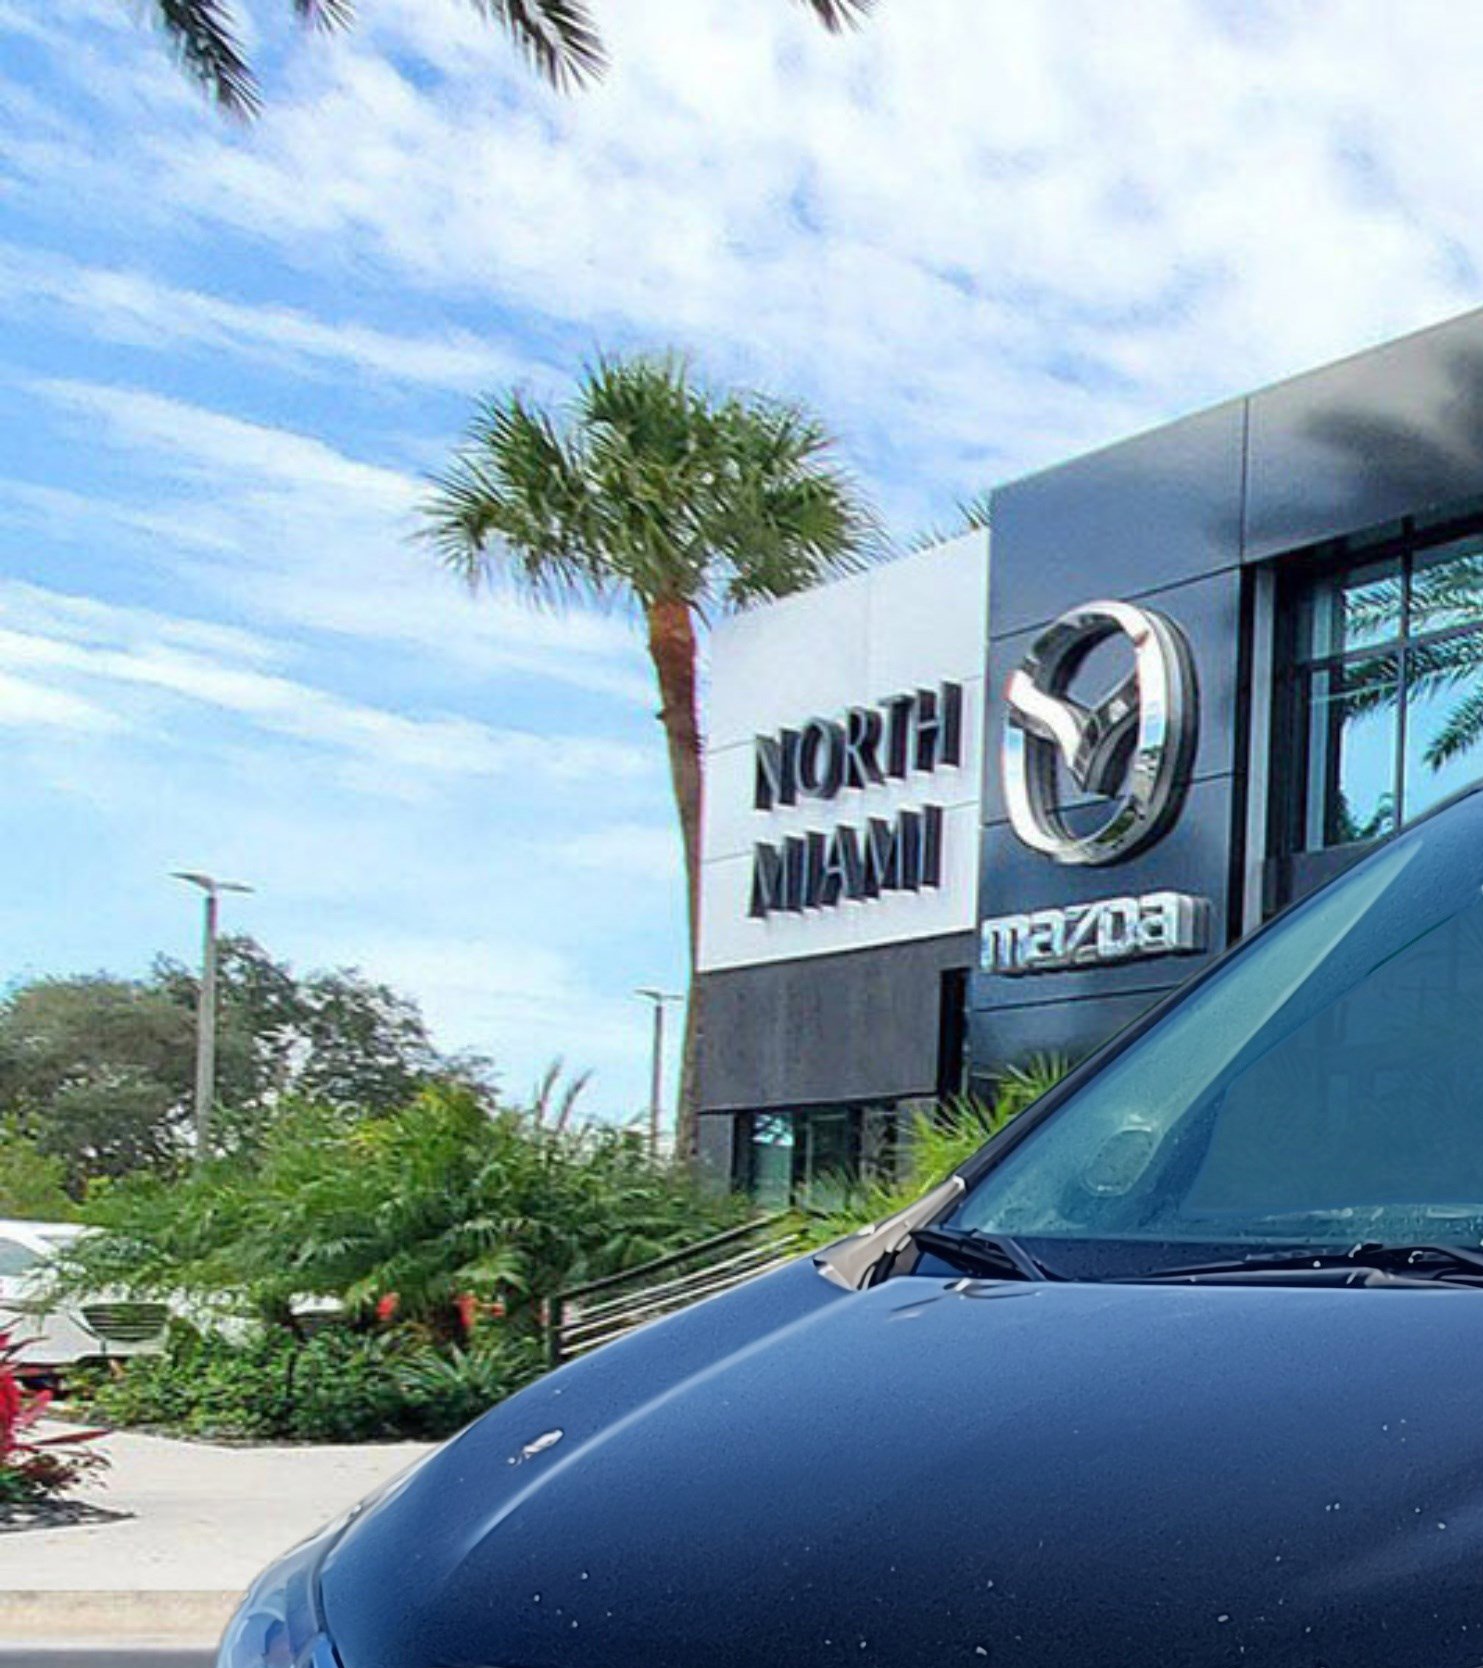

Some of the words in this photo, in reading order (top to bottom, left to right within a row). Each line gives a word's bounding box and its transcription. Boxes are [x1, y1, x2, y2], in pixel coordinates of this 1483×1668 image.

[754, 681, 963, 811] NORTH
[749, 805, 943, 918] MIAMI
[980, 891, 1204, 976] mazda
